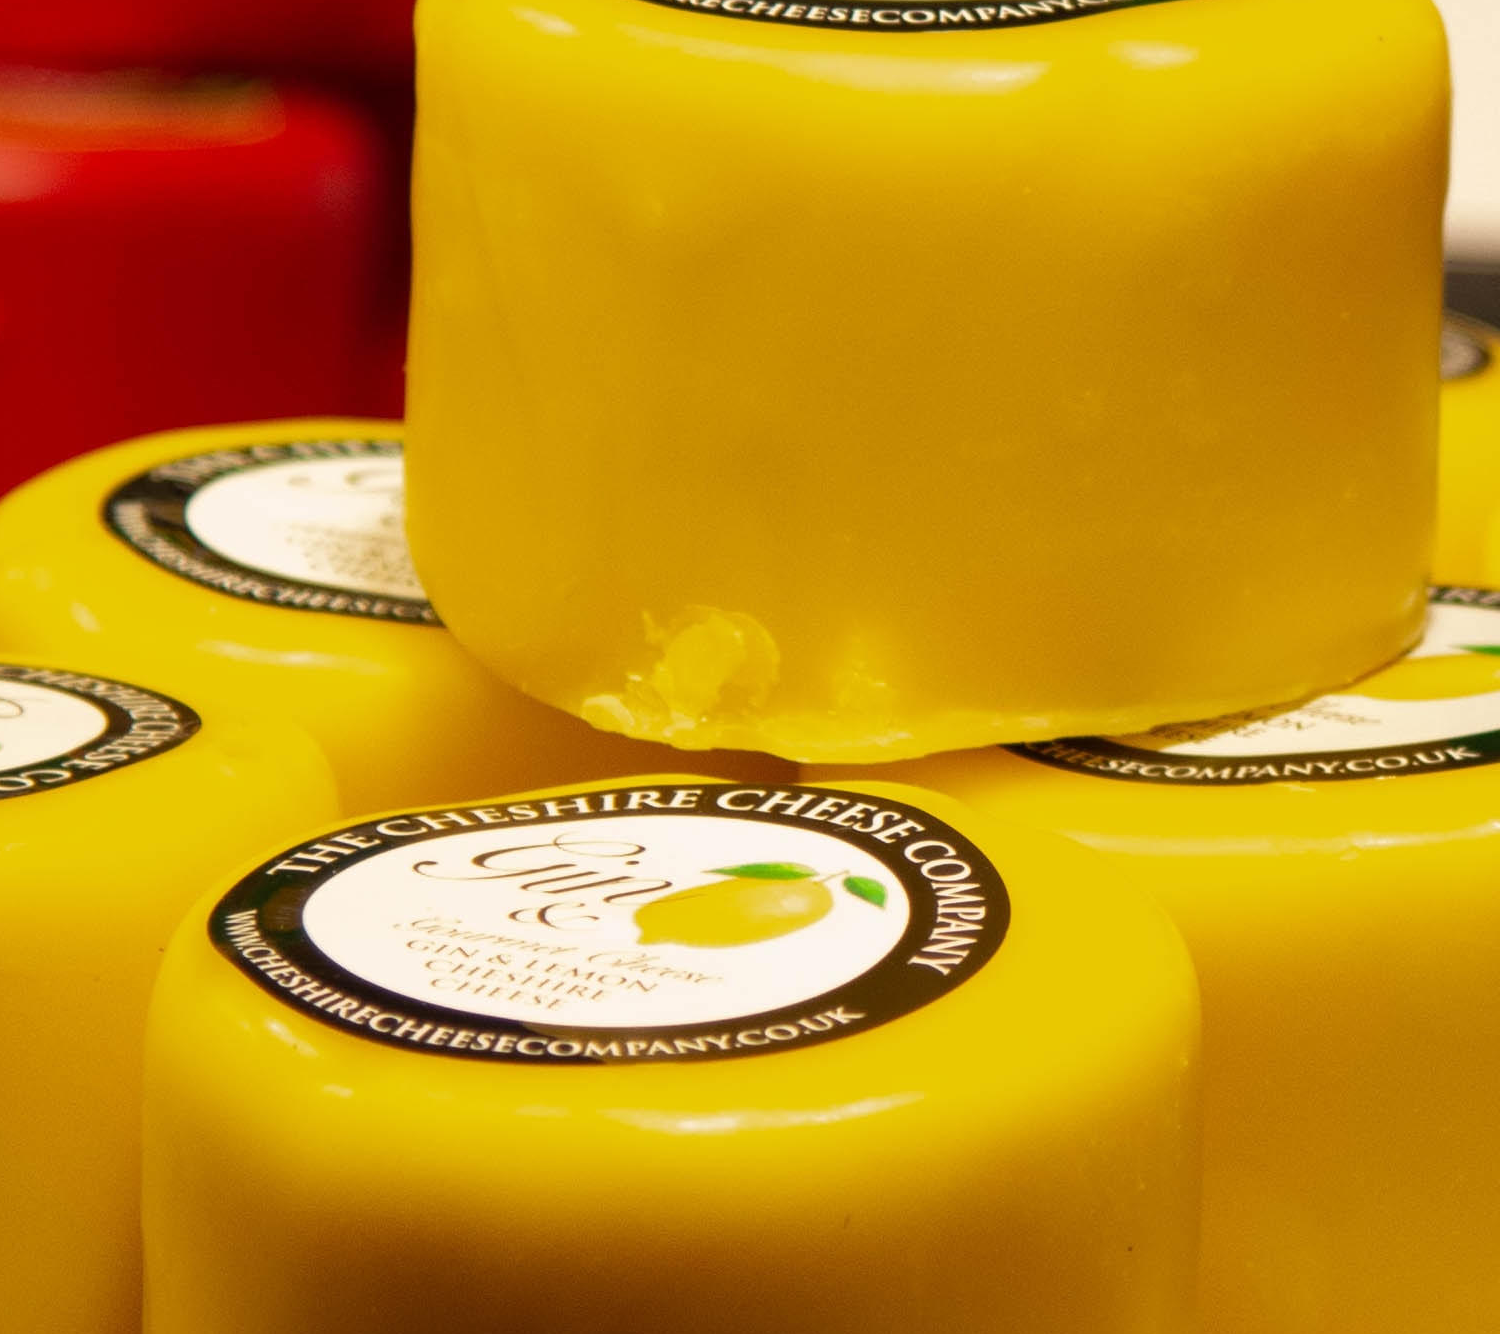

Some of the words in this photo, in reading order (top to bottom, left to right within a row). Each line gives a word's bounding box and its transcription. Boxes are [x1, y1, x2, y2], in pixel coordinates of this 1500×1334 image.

[266, 830, 382, 877] THE
[376, 788, 703, 838] CHESHIRE
[716, 788, 925, 845] CHEESE
[903, 839, 987, 976] COMPANY
[412, 830, 690, 906] Gin
[508, 901, 600, 930] &
[225, 908, 868, 1058] WWW.CHESHIRECHEESECOMPANY.CO.UK
[406, 939, 480, 958] GIN
[487, 953, 511, 966] &
[526, 959, 658, 993] LEMON
[424, 959, 613, 1001] CHESHIRE
[429, 978, 565, 1010] CHEESE
